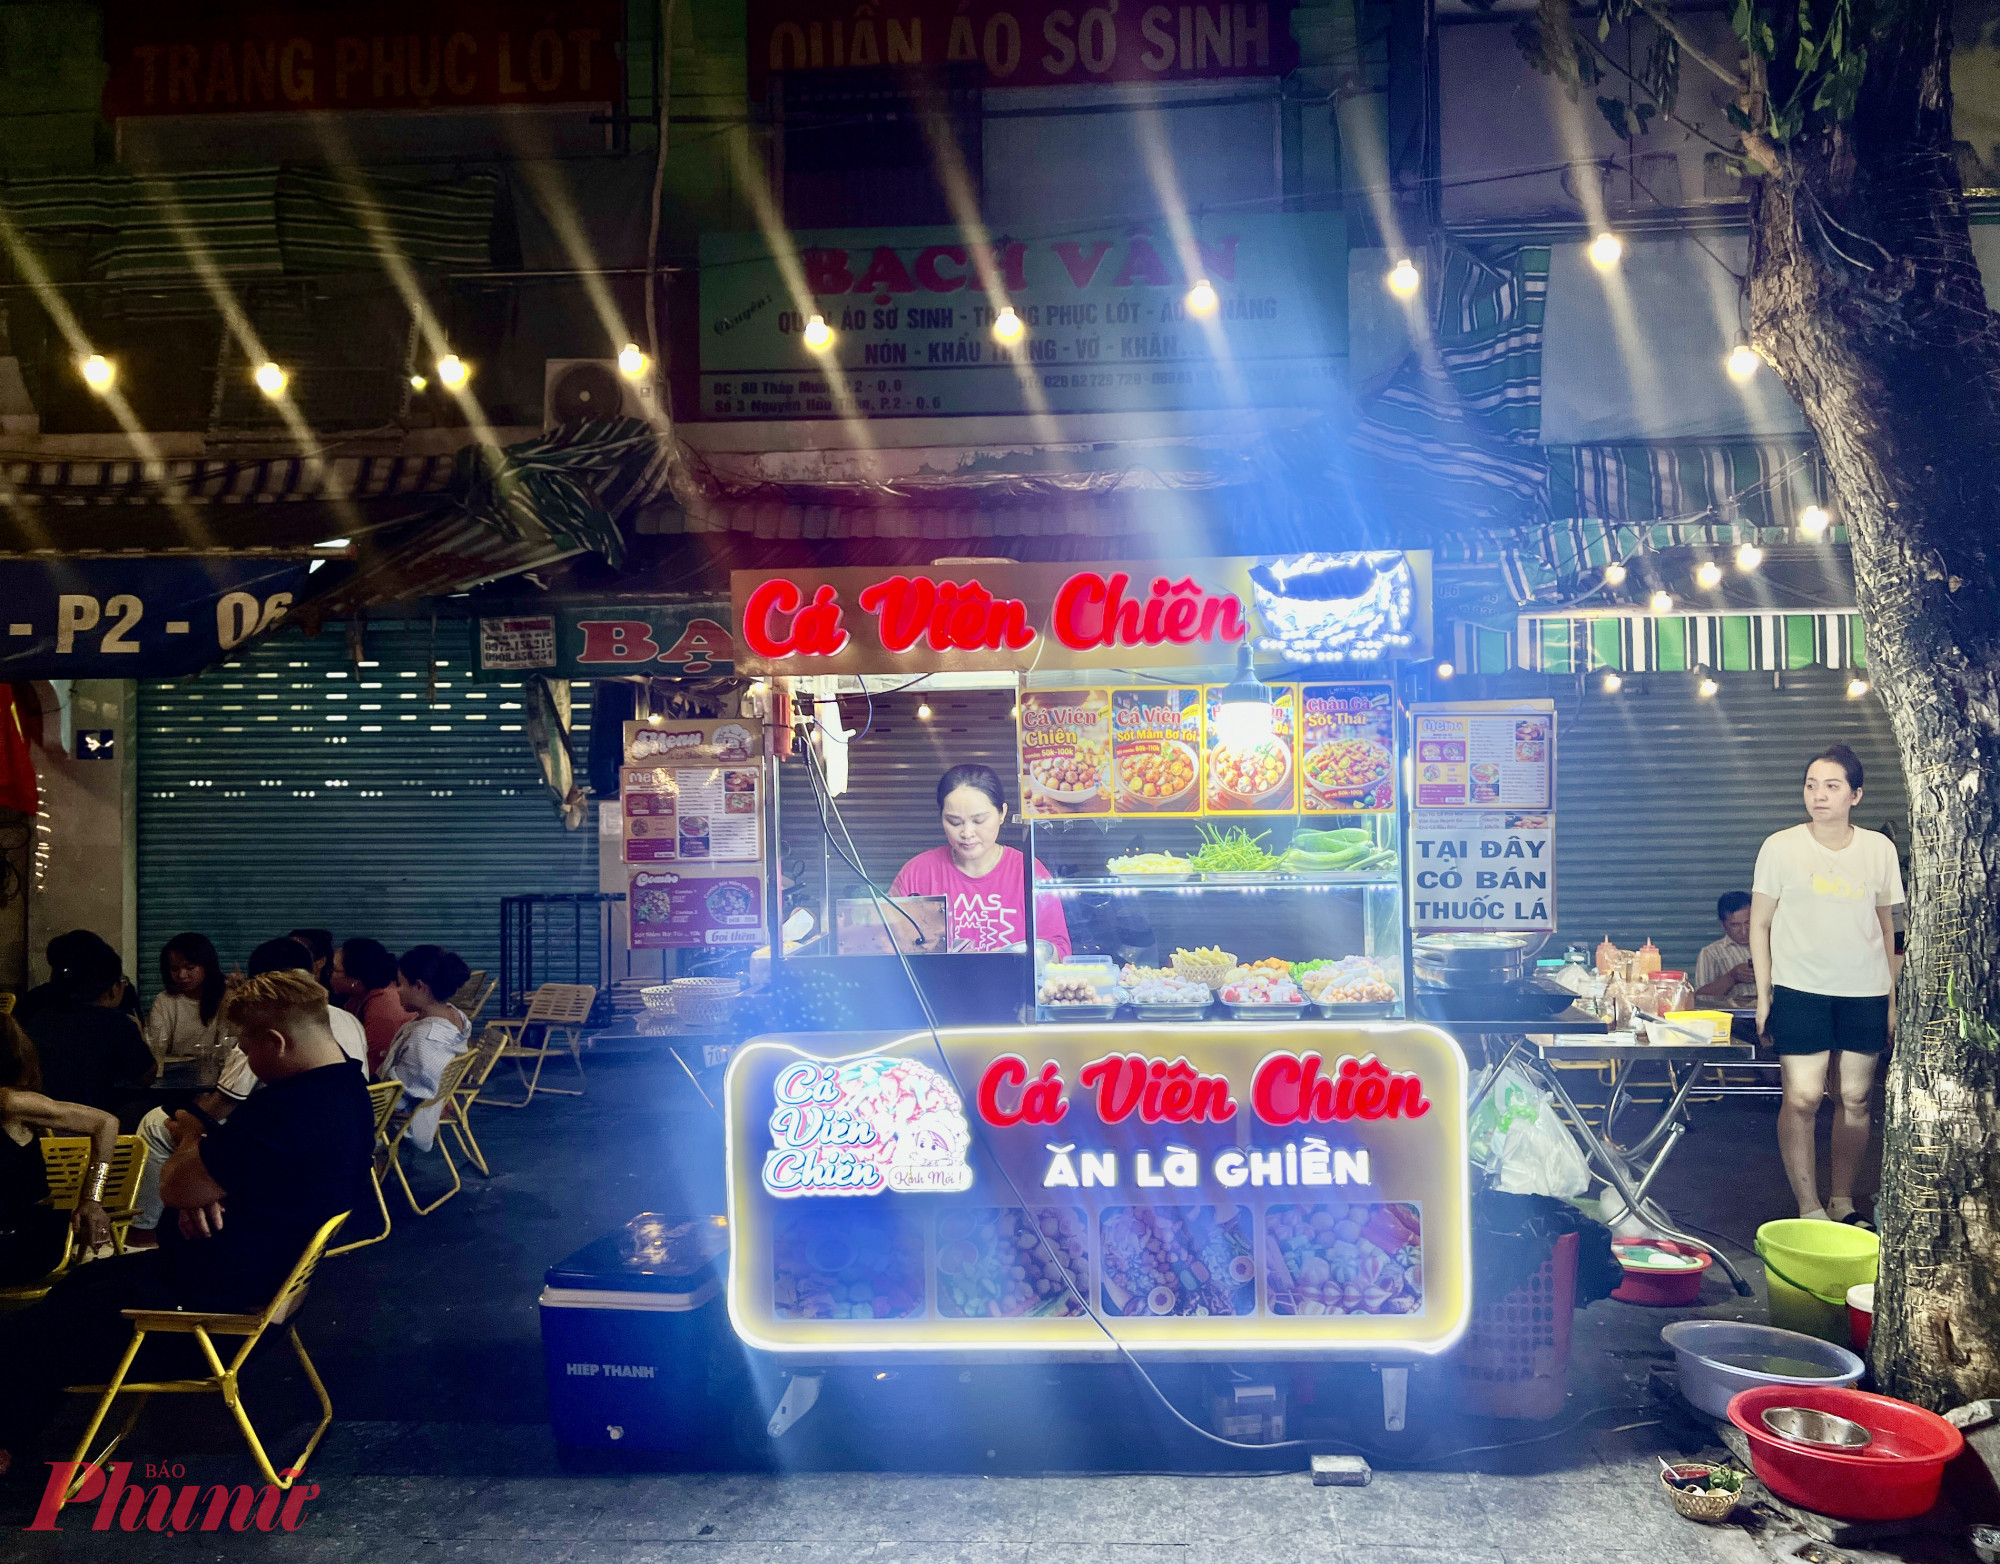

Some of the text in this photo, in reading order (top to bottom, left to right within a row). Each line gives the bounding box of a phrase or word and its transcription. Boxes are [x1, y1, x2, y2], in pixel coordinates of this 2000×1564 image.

[1138, 4, 1270, 70] SINH
[131, 37, 317, 104] TRANG
[333, 33, 477, 109] PHỤC
[906, 307, 954, 330] SINH
[1046, 302, 1099, 330] PHỤC
[55, 593, 144, 653] P2
[742, 569, 1250, 660] Cá Viên Chiên
[1024, 708, 1050, 728] Cá
[1052, 706, 1098, 726] Viên
[1116, 706, 1141, 727] Cá
[1143, 705, 1181, 725] Viên
[1306, 696, 1348, 712] Chân
[1308, 711, 1368, 732] Sốt Thái
[1025, 727, 1078, 749] Chiên
[1415, 835, 1547, 862] TẠI ĐÂY
[1416, 865, 1547, 890] CÓ BÁN
[1414, 894, 1549, 920] THUỐC LÁ
[775, 1061, 840, 1105] Cá
[976, 1048, 1432, 1127] Cá Viên Chiên
[770, 1105, 877, 1147] Viên
[763, 1148, 881, 1190] Chiên
[1042, 1142, 1117, 1188] ĂN
